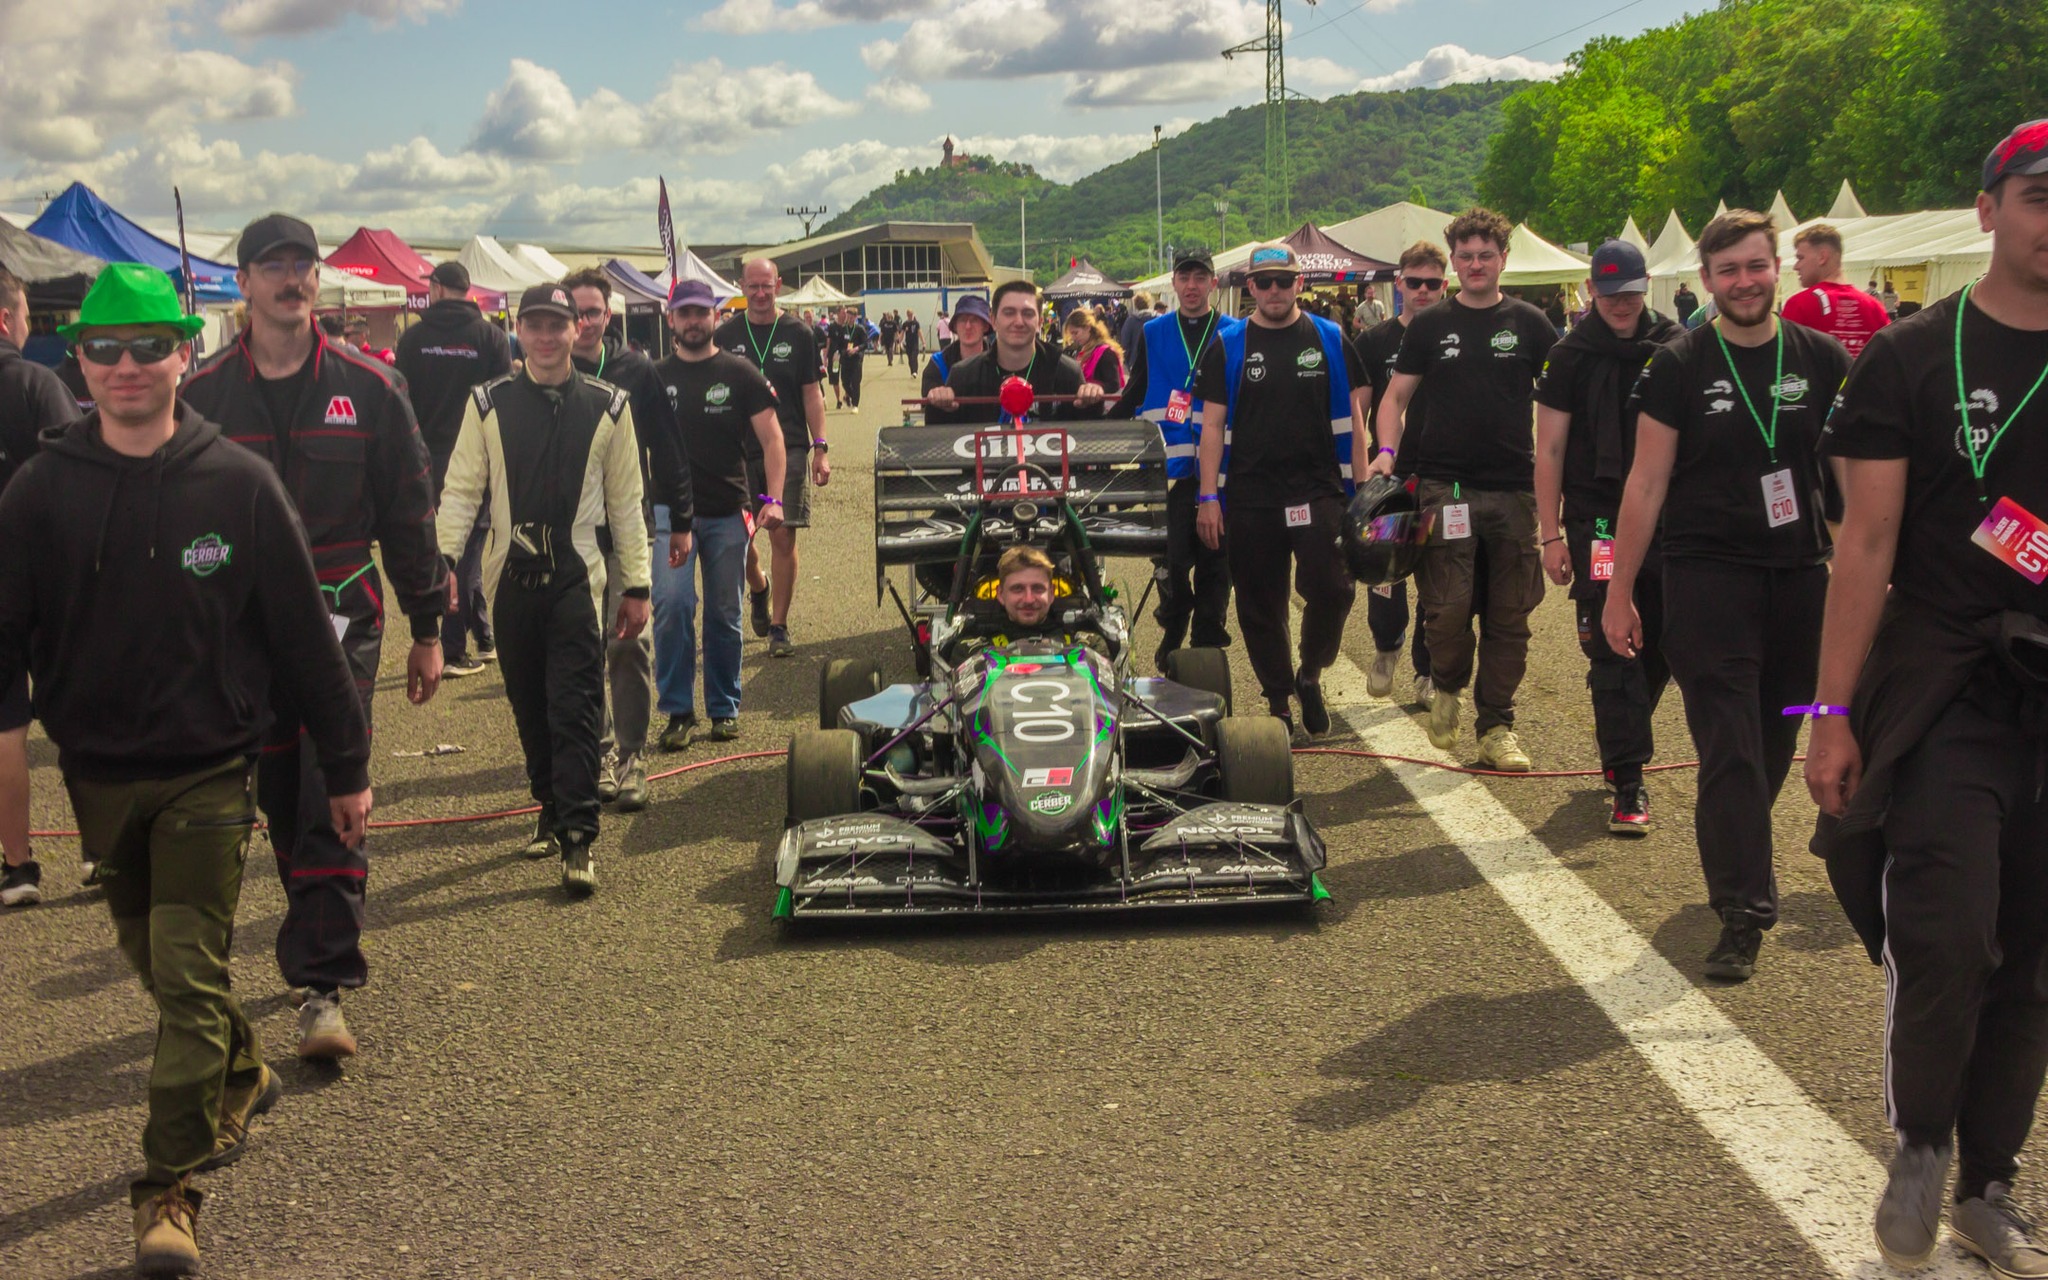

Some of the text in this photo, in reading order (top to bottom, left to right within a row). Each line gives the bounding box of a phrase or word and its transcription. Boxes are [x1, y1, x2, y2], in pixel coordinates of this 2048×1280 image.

[405, 294, 430, 309] ntel
[1168, 406, 1184, 420] C10
[1290, 509, 1307, 521] C10
[1772, 498, 1793, 519] C10
[184, 544, 230, 567] CERBER
[1594, 562, 1614, 576] C10
[1011, 681, 1075, 742] C10
[1030, 795, 1072, 811] CERBER
[1231, 814, 1273, 822] PREMIUM
[839, 823, 881, 833] PREMIUM
[1177, 826, 1273, 835] NOVOL
[816, 835, 912, 848] NOVOL
